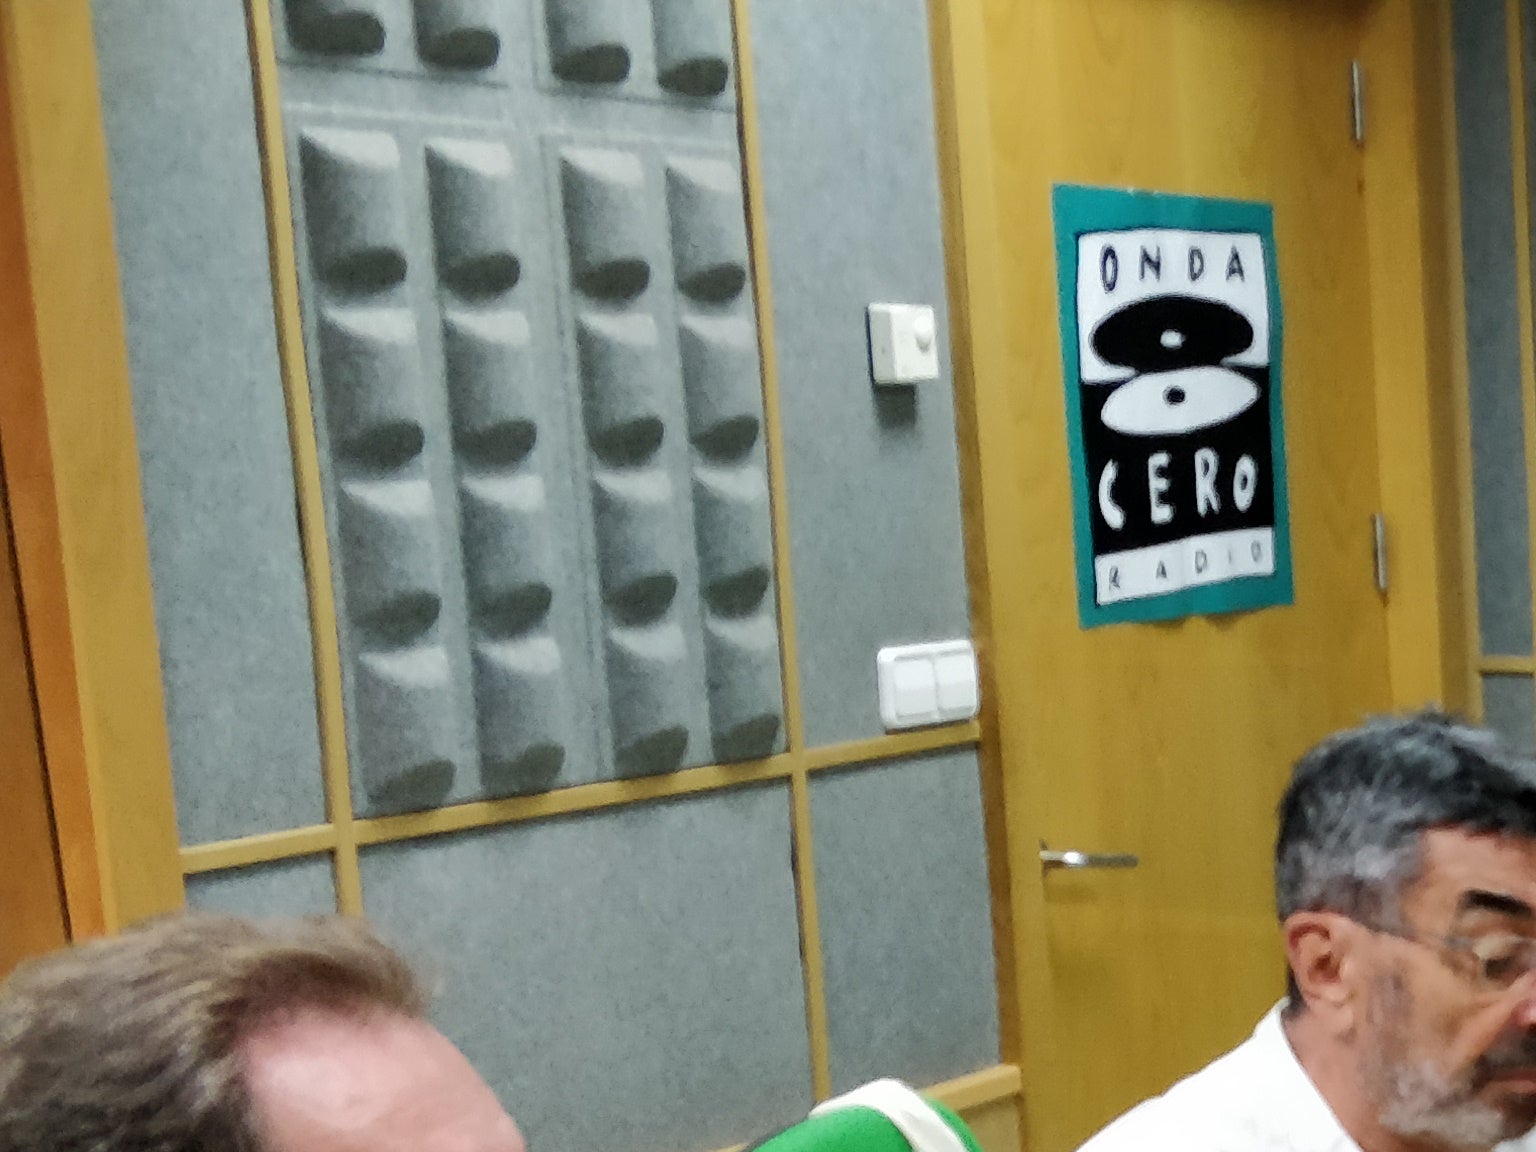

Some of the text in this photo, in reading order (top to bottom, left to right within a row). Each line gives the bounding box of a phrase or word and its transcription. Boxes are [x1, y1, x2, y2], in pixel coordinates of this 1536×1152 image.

[1100, 245, 1246, 291] ONDA
[1098, 447, 1258, 530] CERO
[1109, 540, 1261, 591] RADIO
